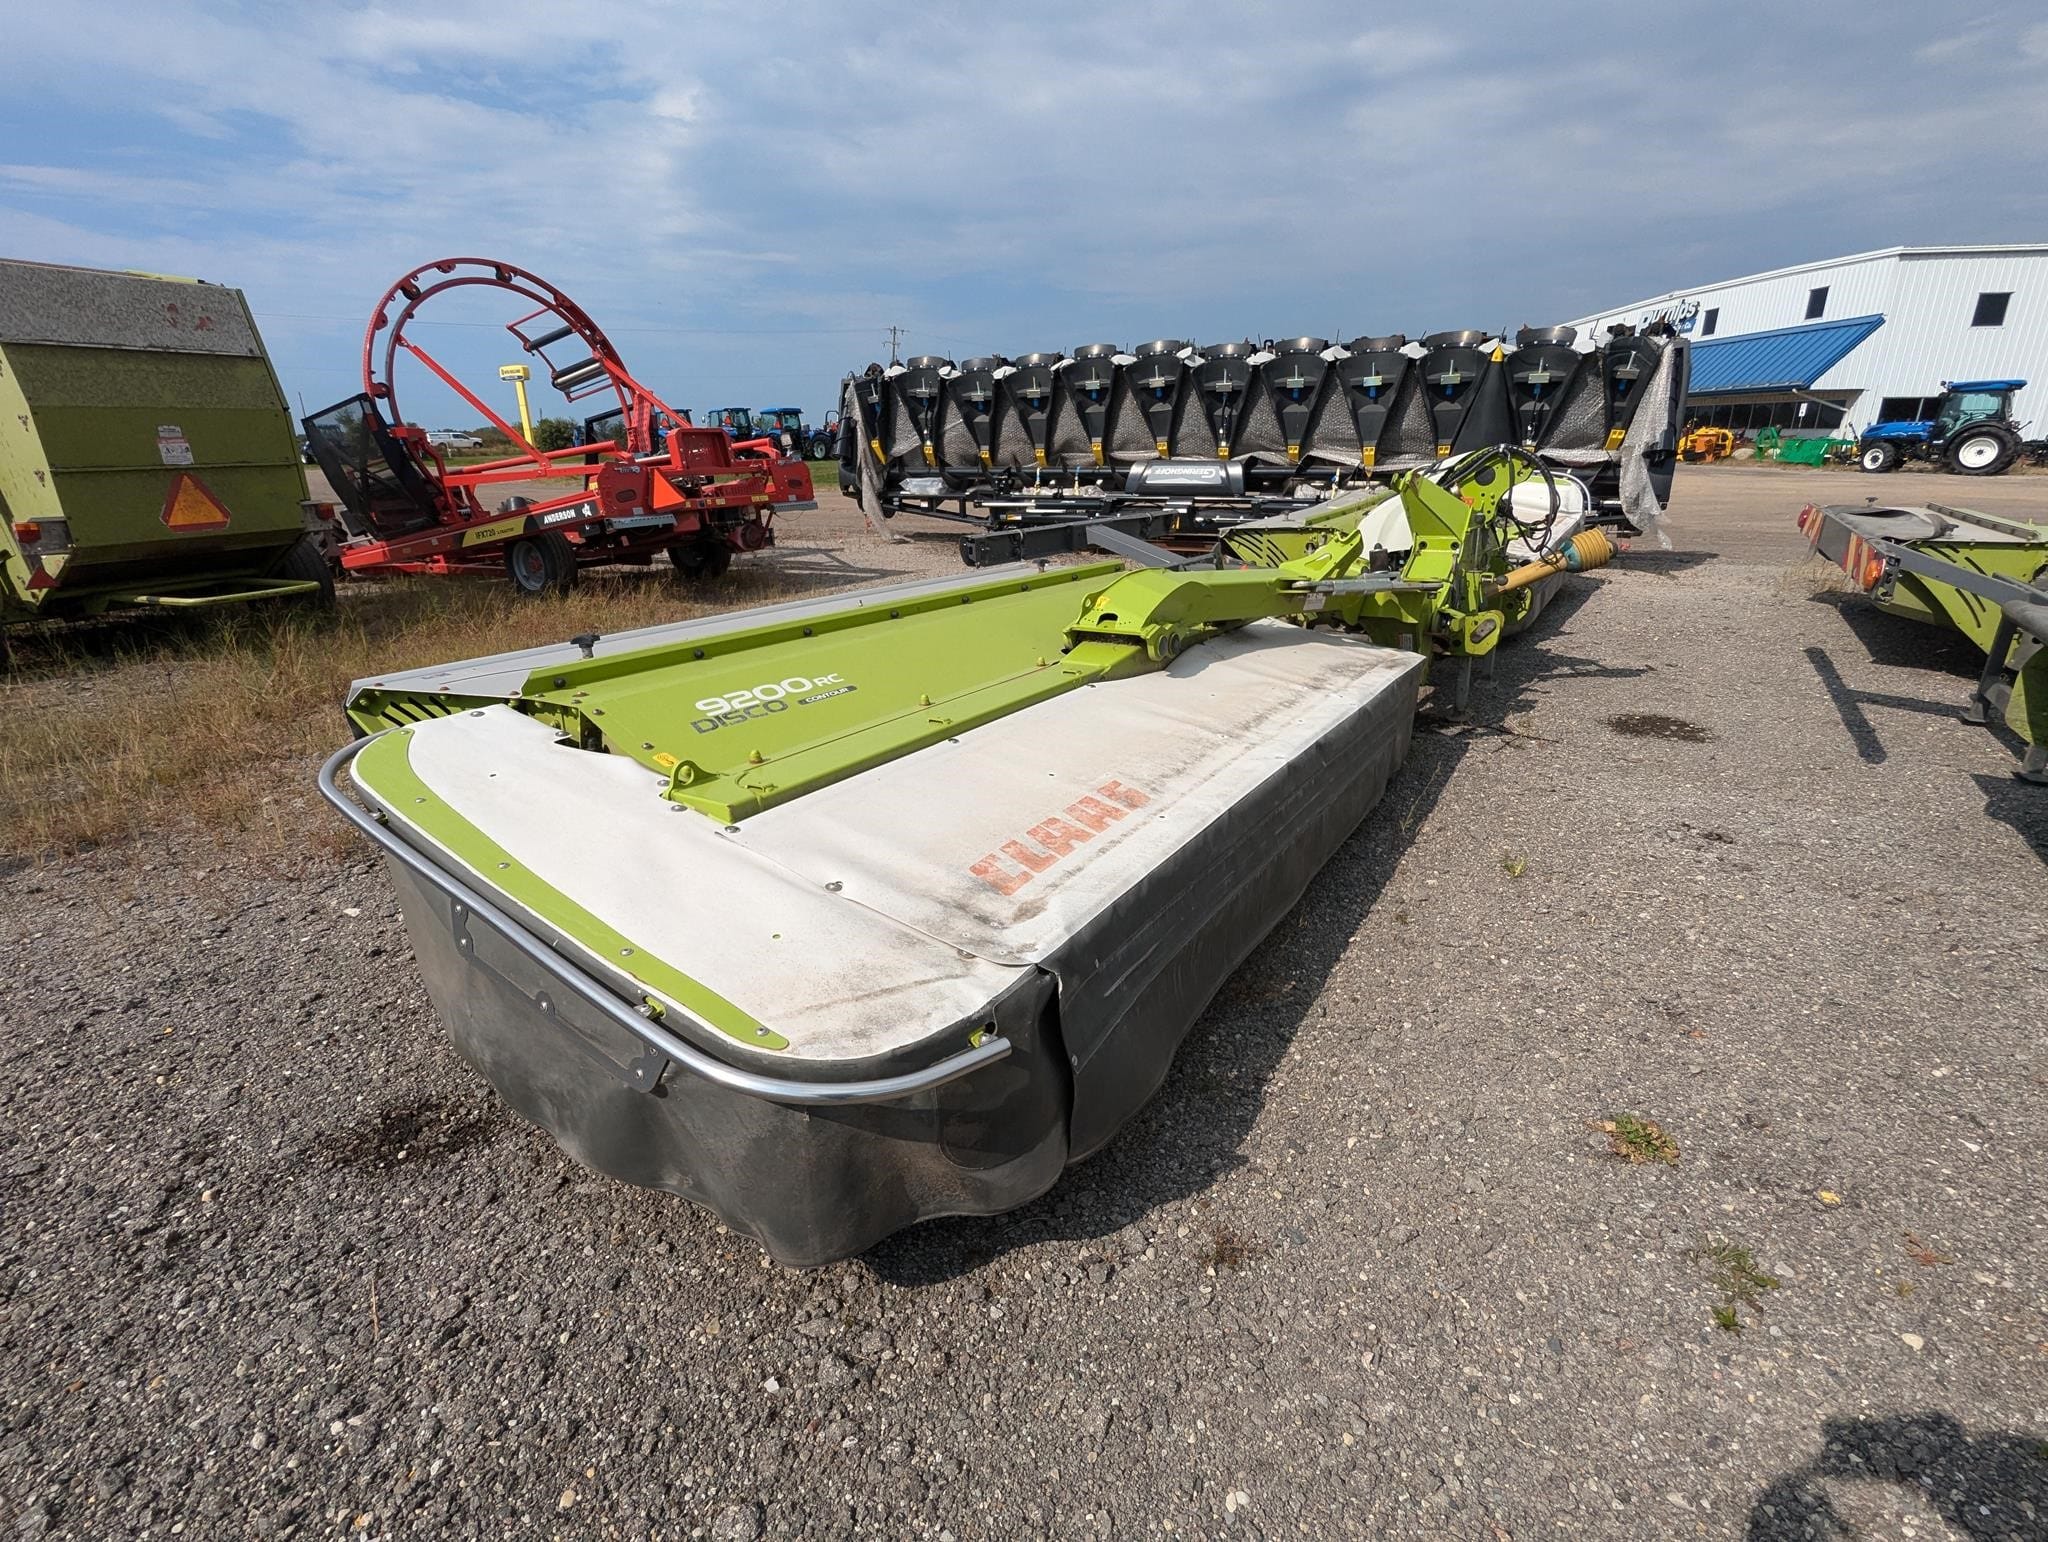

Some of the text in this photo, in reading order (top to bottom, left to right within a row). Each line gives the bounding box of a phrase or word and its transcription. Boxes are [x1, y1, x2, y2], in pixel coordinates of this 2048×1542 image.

[1154, 468, 1216, 479] GERINGHOFF
[543, 509, 576, 525] ANDERSON
[695, 673, 845, 717] 9200 RC
[805, 687, 849, 703] CONTOUR
[690, 700, 789, 734] DISCO
[968, 779, 1152, 897] CLAAS
